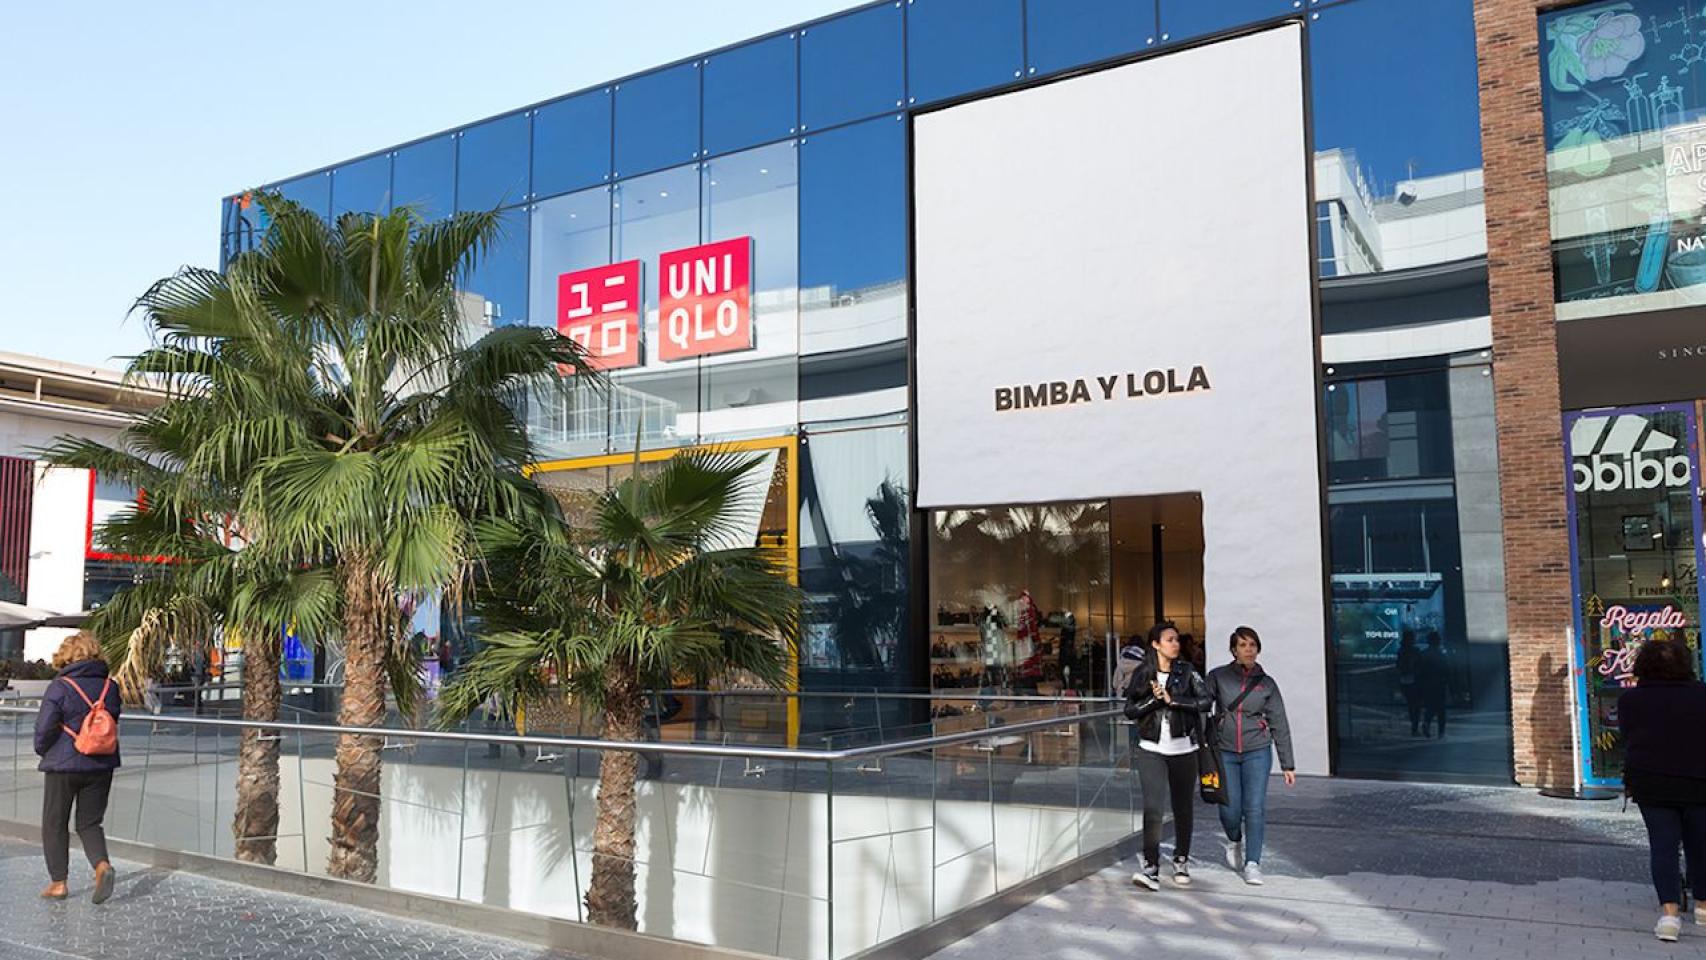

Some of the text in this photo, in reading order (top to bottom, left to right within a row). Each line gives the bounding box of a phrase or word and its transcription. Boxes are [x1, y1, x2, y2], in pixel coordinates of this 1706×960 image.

[1677, 235, 1706, 253] NA
[669, 253, 733, 300] UNI
[668, 299, 738, 349] QLO
[995, 365, 1211, 411] BIMBA Y LOLA
[1600, 605, 1686, 634] Regala
